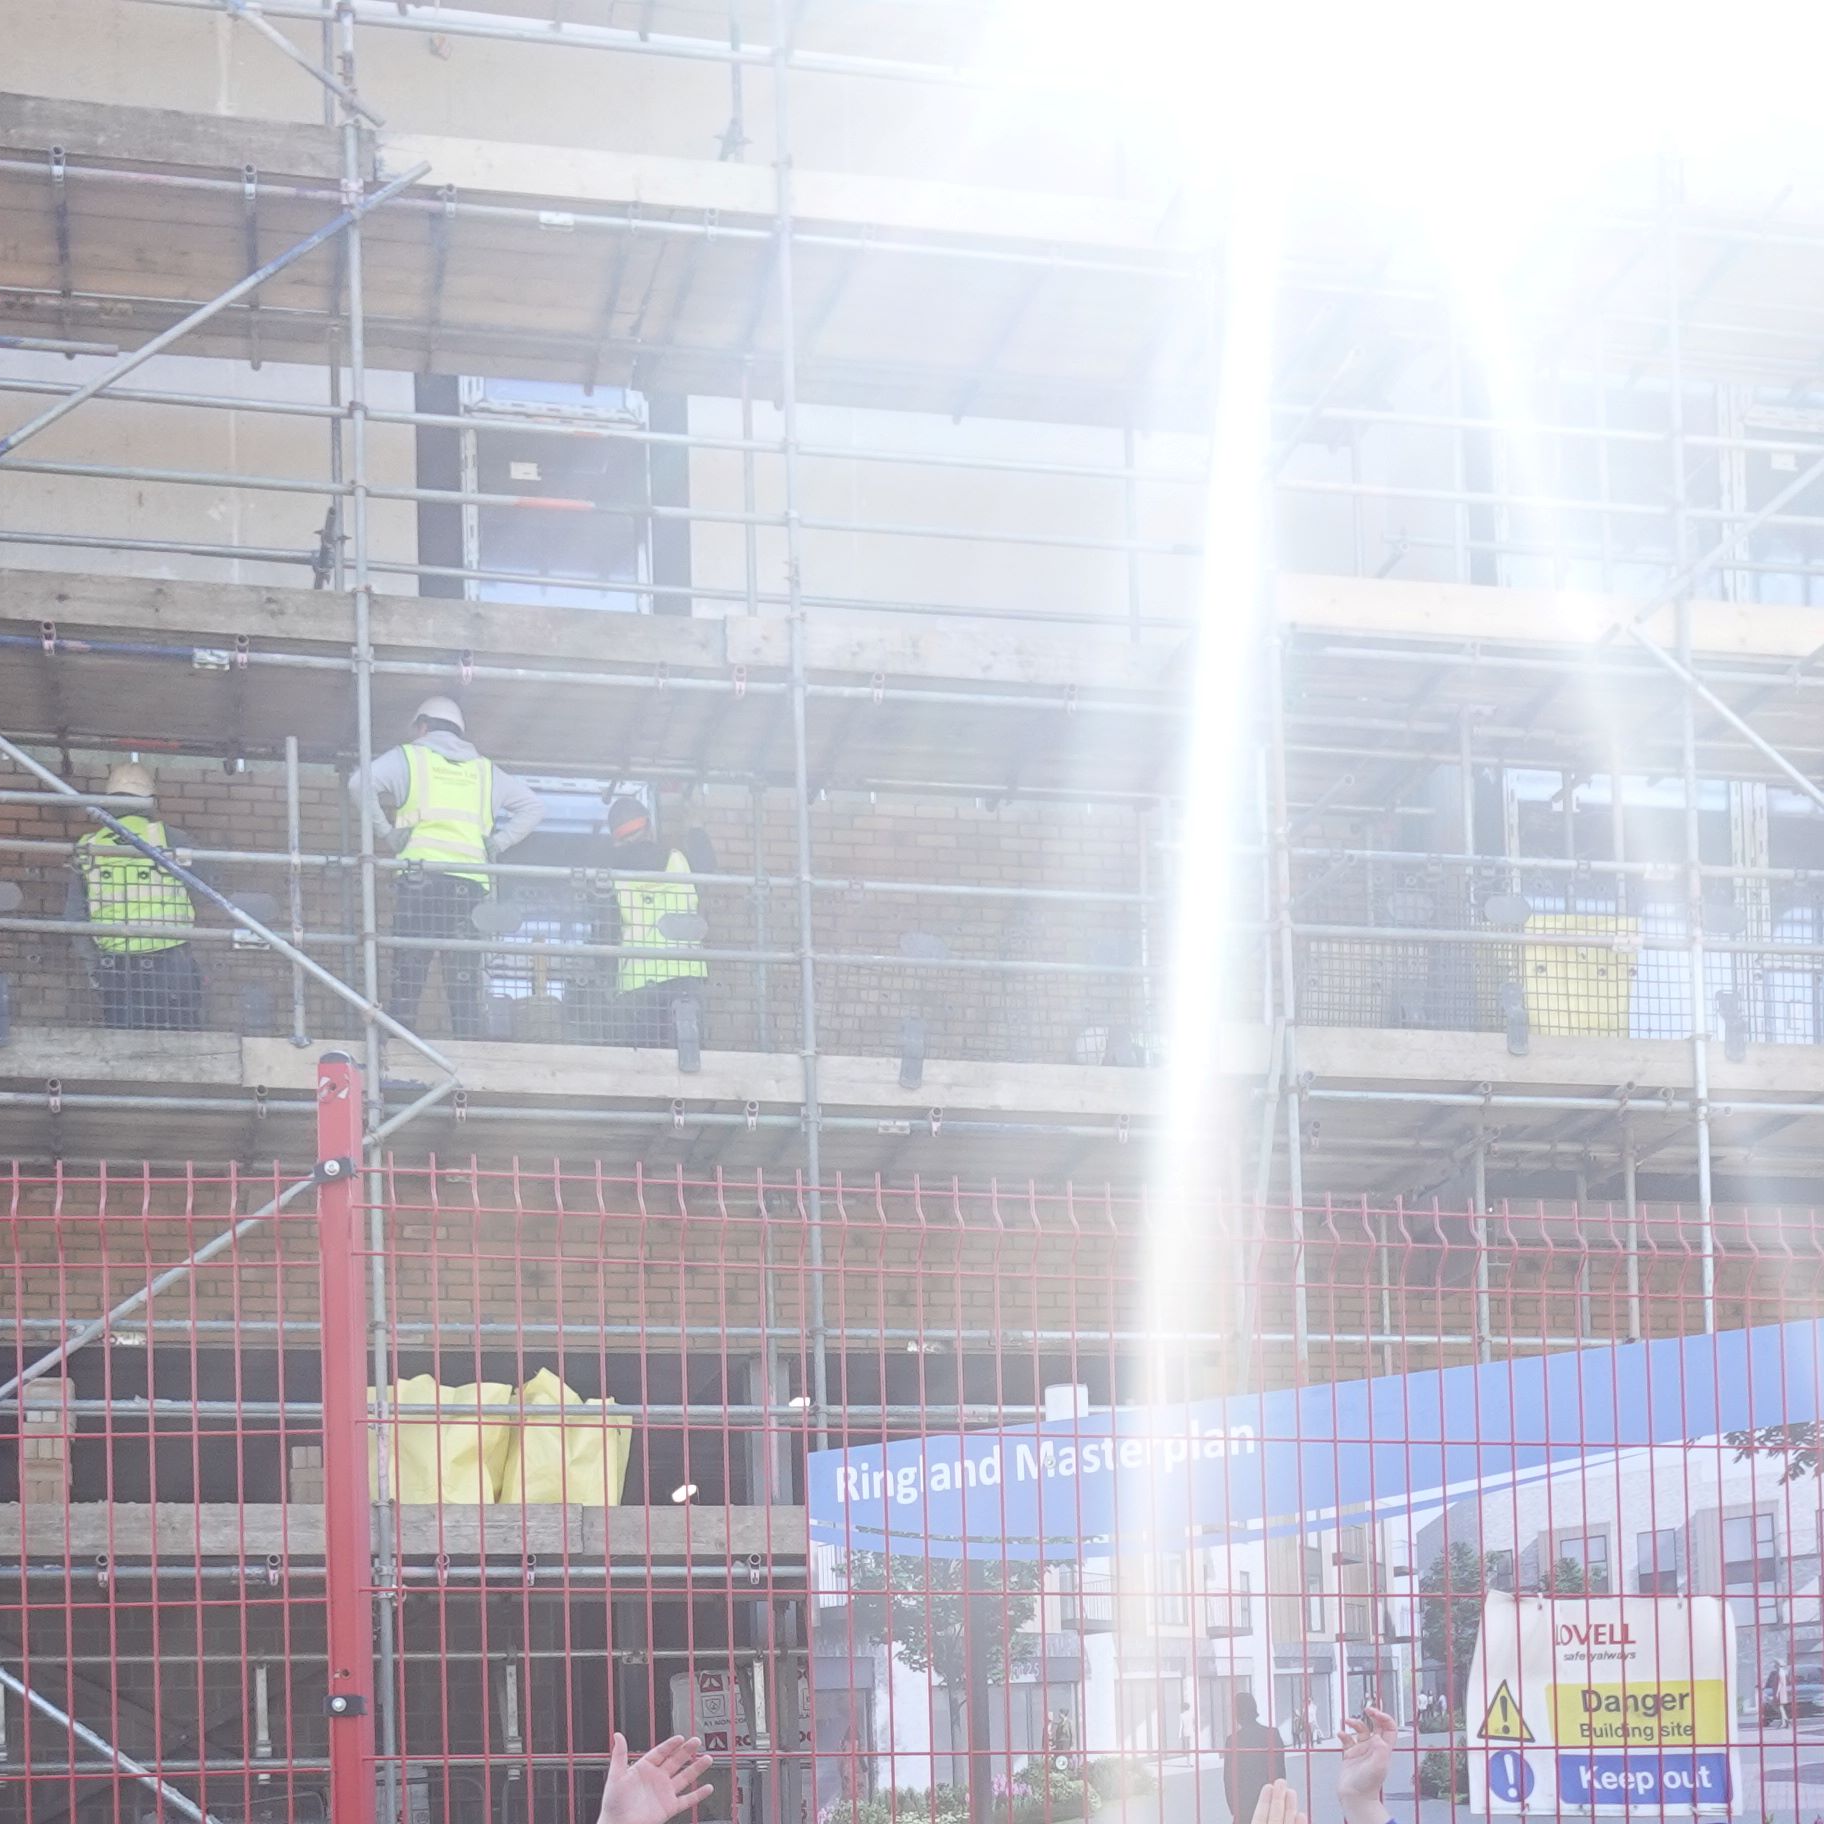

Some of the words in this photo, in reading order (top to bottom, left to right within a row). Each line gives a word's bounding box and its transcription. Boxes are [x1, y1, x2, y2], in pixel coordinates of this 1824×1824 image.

[836, 1444, 1001, 1505] Ringland
[1016, 1418, 1256, 1483] Masterplan
[1563, 1651, 1637, 1662] safeyalways
[1580, 1689, 1691, 1717] Danger
[1579, 1722, 1655, 1741] Building
[1660, 1722, 1695, 1737] site
[1578, 1765, 1655, 1795] Keep
[1663, 1765, 1712, 1789] out
